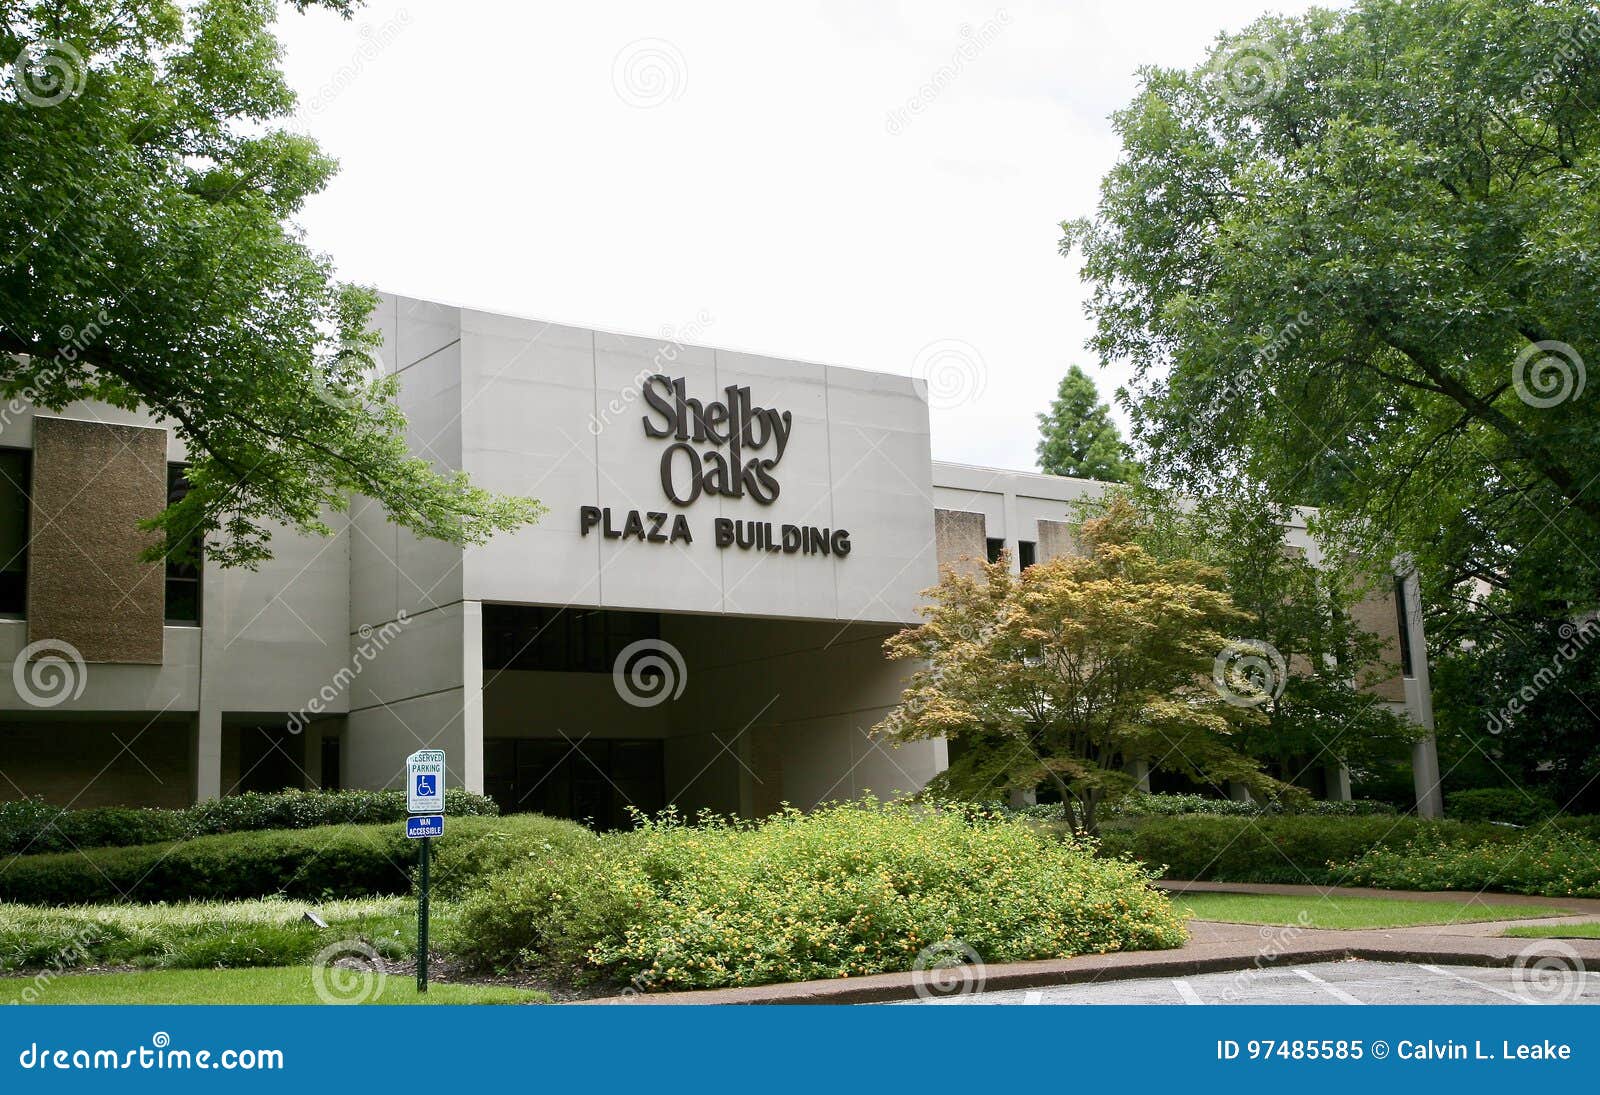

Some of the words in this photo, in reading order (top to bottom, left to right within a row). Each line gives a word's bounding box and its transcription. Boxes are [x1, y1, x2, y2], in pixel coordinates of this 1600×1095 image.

[642, 374, 792, 468] Shelby
[660, 442, 781, 507] Oaks
[580, 505, 693, 545] PLAZA
[714, 517, 852, 558] BUILDING
[412, 753, 443, 762] ESERVED
[412, 764, 441, 773] PARKING
[419, 818, 431, 826] VAN
[409, 826, 441, 836] ACCESSIBLE
